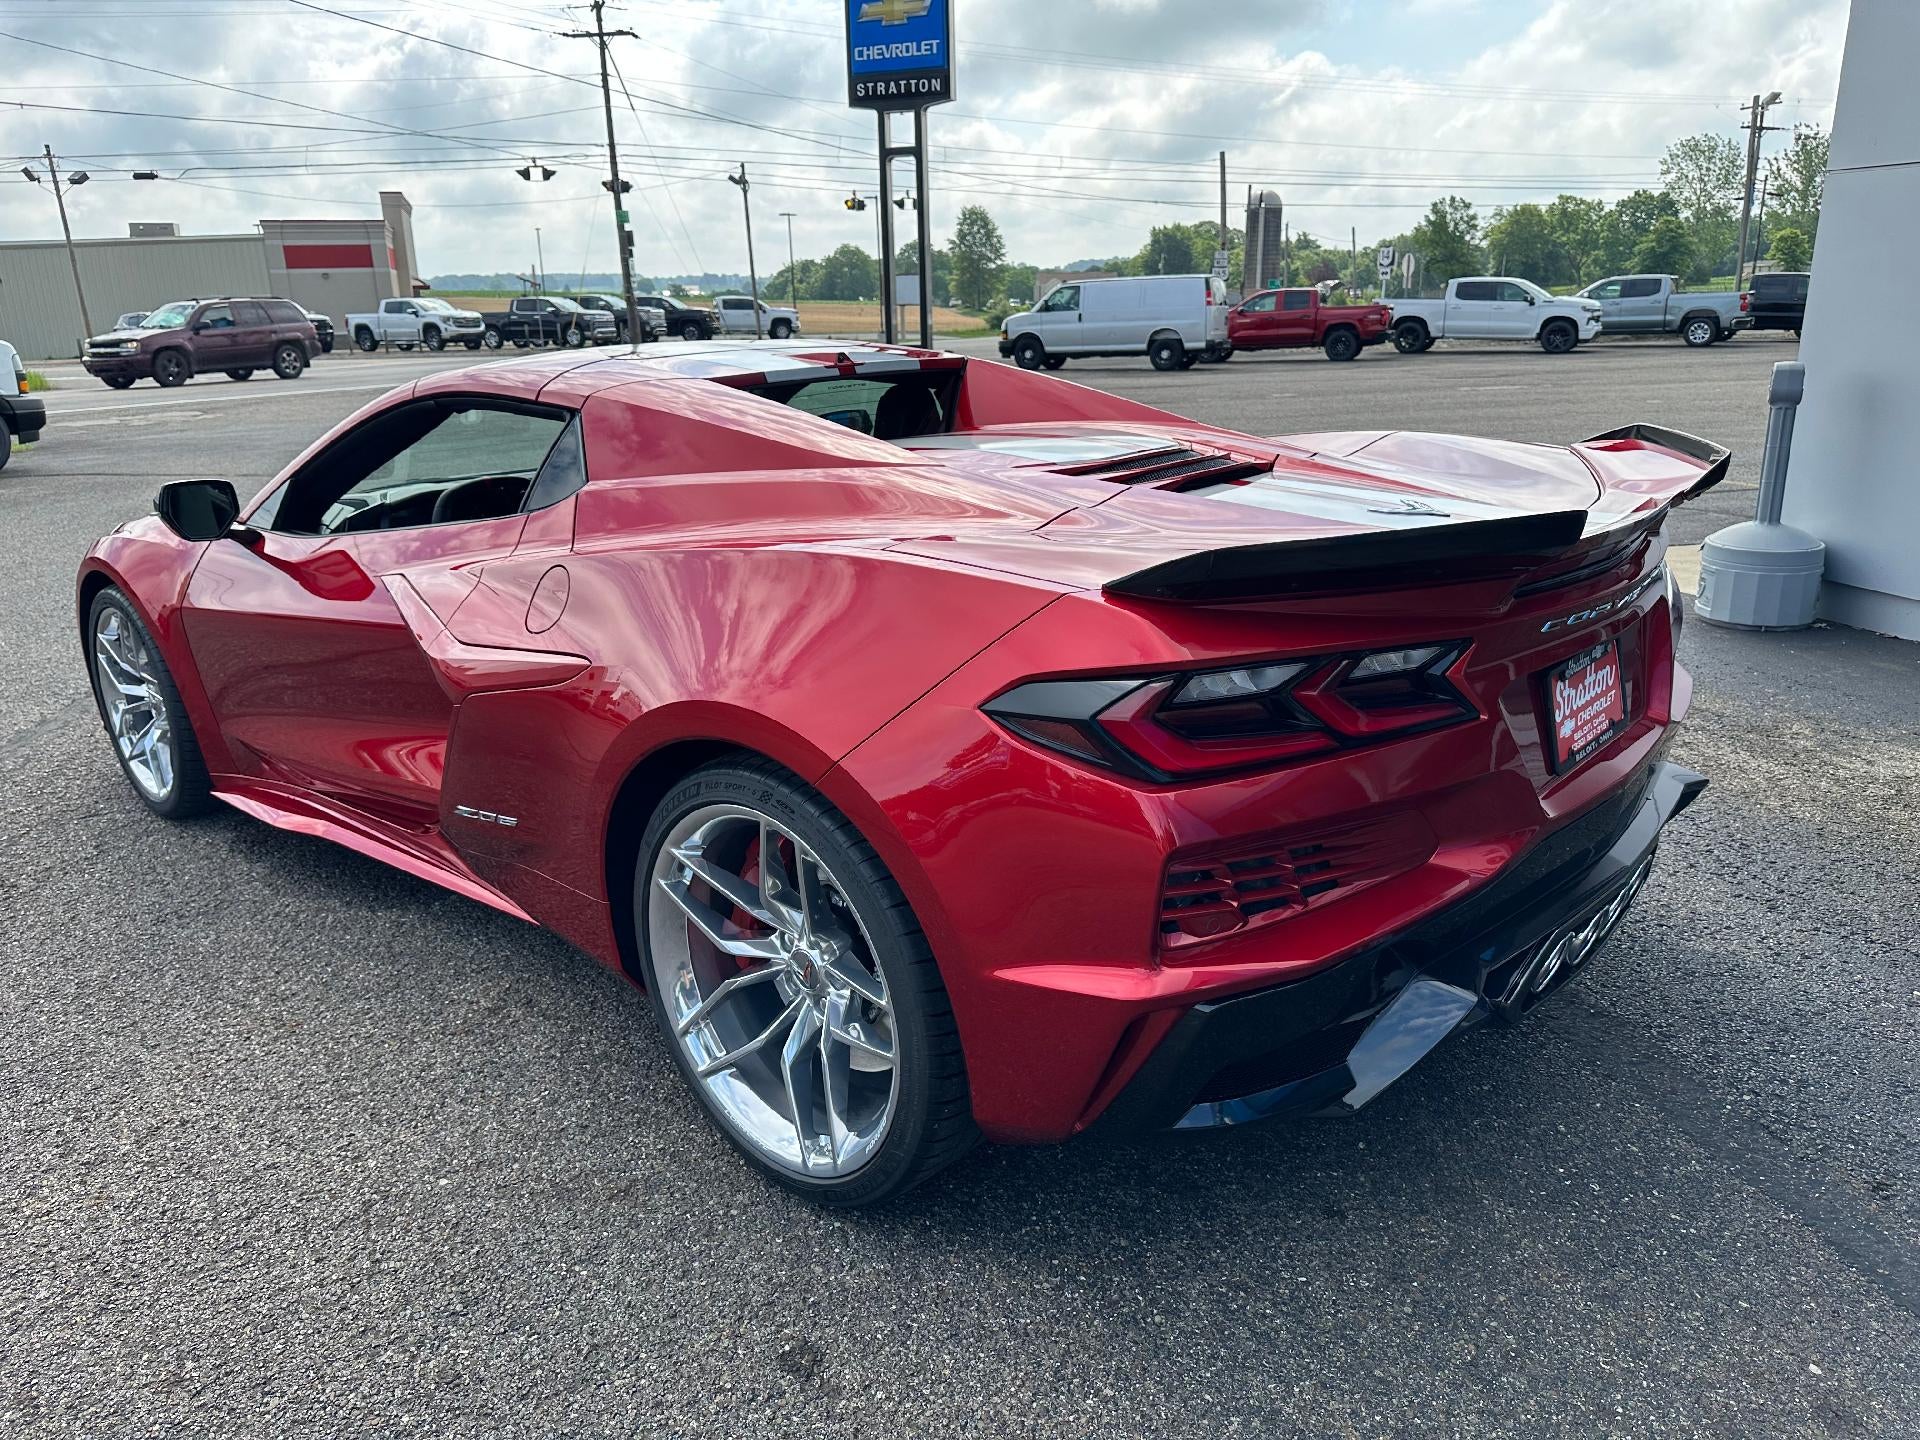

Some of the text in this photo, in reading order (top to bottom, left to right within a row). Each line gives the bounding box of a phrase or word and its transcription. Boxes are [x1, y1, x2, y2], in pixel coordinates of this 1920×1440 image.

[854, 39, 940, 61] CHEVROLET
[856, 78, 941, 97] STRATTON
[1555, 662, 1616, 722] Stratton
[1577, 689, 1616, 726] CHEVROLET
